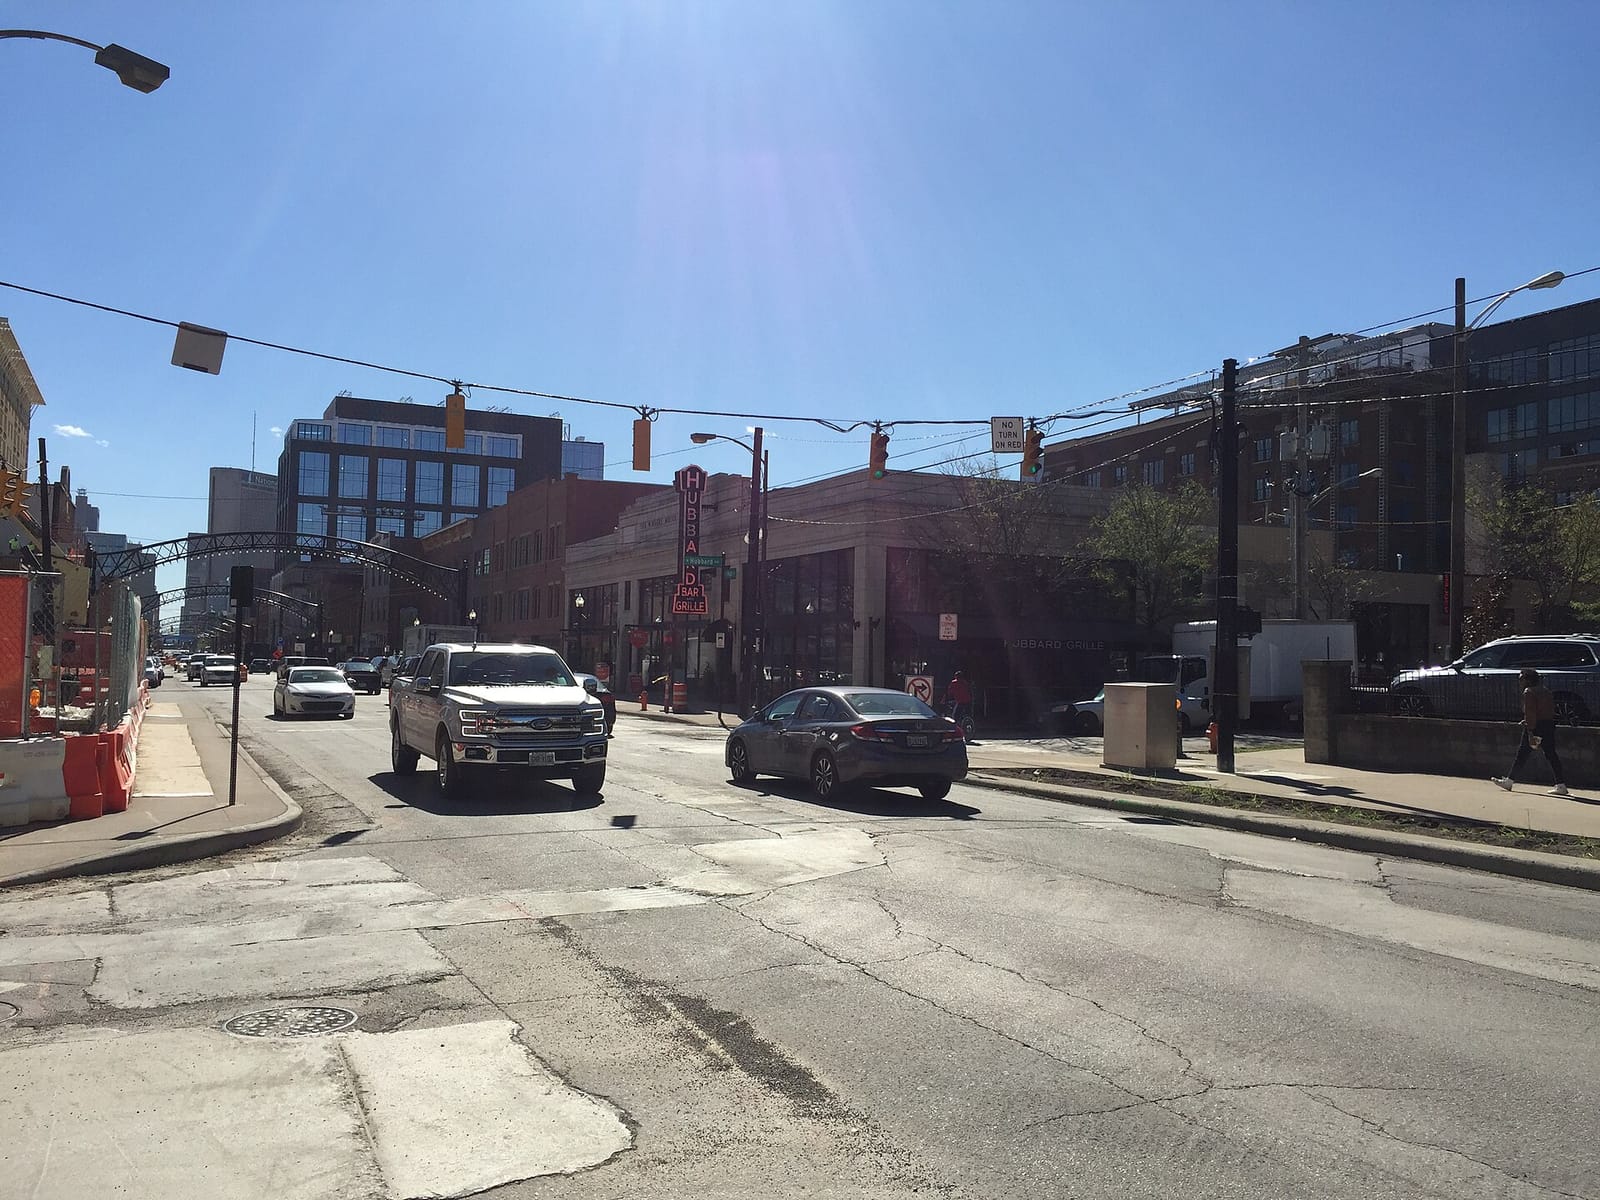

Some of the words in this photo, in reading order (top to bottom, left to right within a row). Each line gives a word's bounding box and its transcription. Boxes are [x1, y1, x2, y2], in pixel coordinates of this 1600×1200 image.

[1001, 421, 1013, 429] NO
[999, 431, 1018, 439] TURN
[995, 440, 1005, 449] ON
[1007, 440, 1022, 449] RED
[686, 471, 699, 585] HUBBAD
[681, 586, 699, 597] BAR
[675, 600, 705, 611] GRILLE
[1066, 640, 1105, 650] GRILLE
